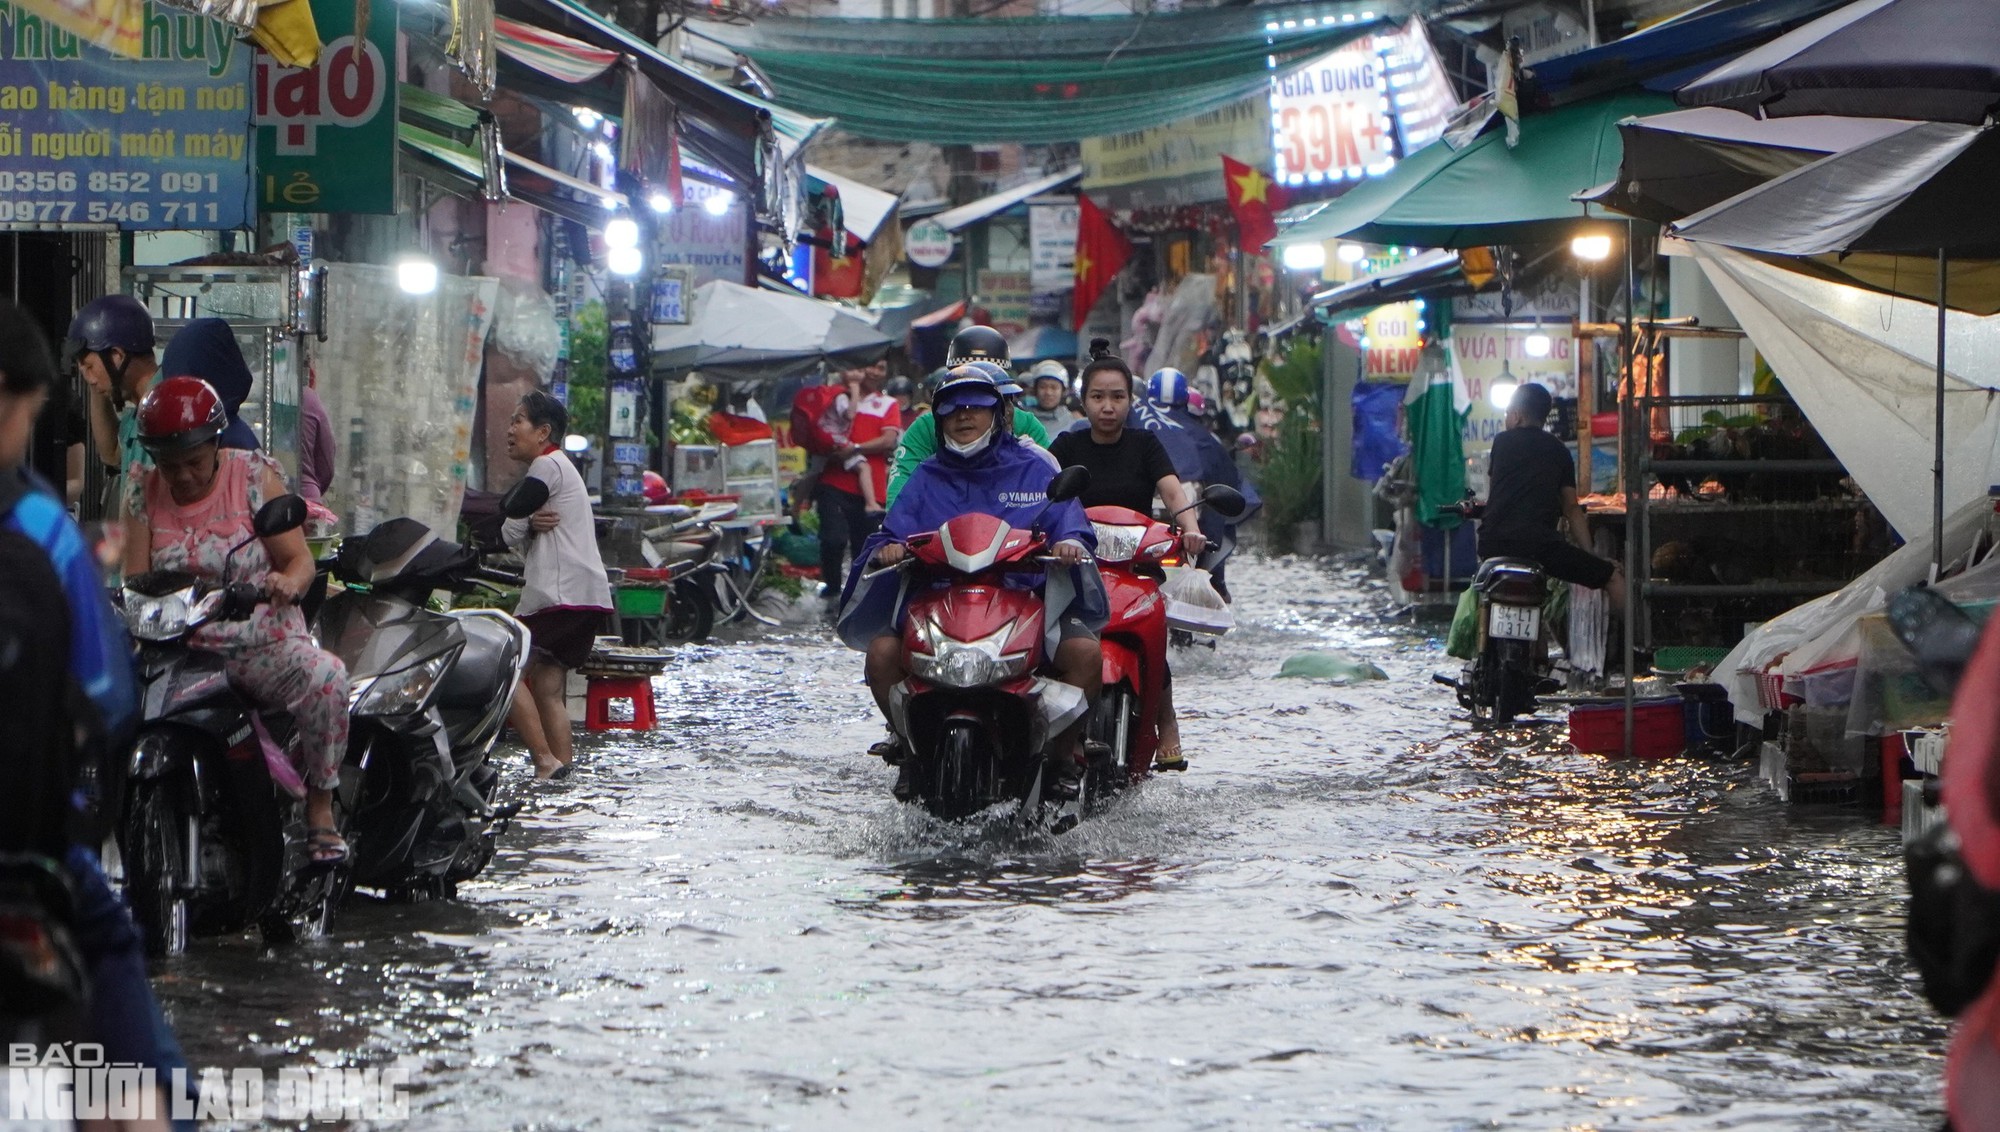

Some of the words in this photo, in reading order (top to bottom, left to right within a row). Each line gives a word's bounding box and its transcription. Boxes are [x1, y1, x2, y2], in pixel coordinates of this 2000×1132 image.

[1282, 70, 1315, 98] GIA
[49, 80, 125, 113] hàng
[136, 80, 185, 117] tận
[196, 82, 246, 110] nơi
[31, 127, 111, 160] người
[121, 128, 175, 163] một
[185, 128, 245, 161] máy
[1282, 101, 1384, 173] 39K+
[0, 171, 77, 193] 0356
[88, 171, 150, 193] 852
[161, 171, 218, 193] 091
[0, 201, 77, 222] 0977
[88, 201, 150, 223] 546
[161, 202, 218, 223] 711
[1008, 491, 1048, 502] YAMAHA
[1496, 621, 1531, 638] 0314
